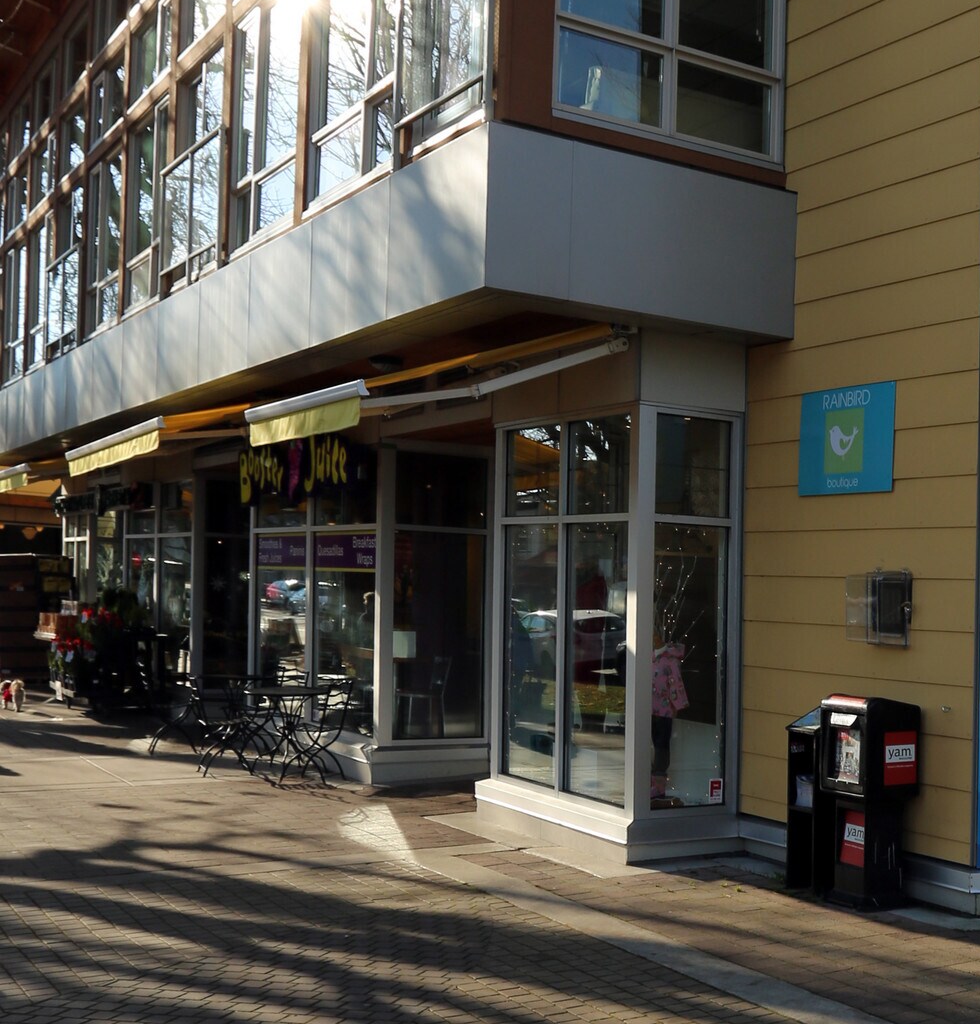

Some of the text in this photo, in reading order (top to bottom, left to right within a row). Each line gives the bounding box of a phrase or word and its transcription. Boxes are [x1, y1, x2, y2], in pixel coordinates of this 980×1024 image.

[822, 389, 872, 410] RAINBIRD
[240, 434, 347, 504] Booster Juice
[826, 477, 859, 489] boutique
[356, 552, 374, 568] Wraps
[888, 747, 912, 760] yam
